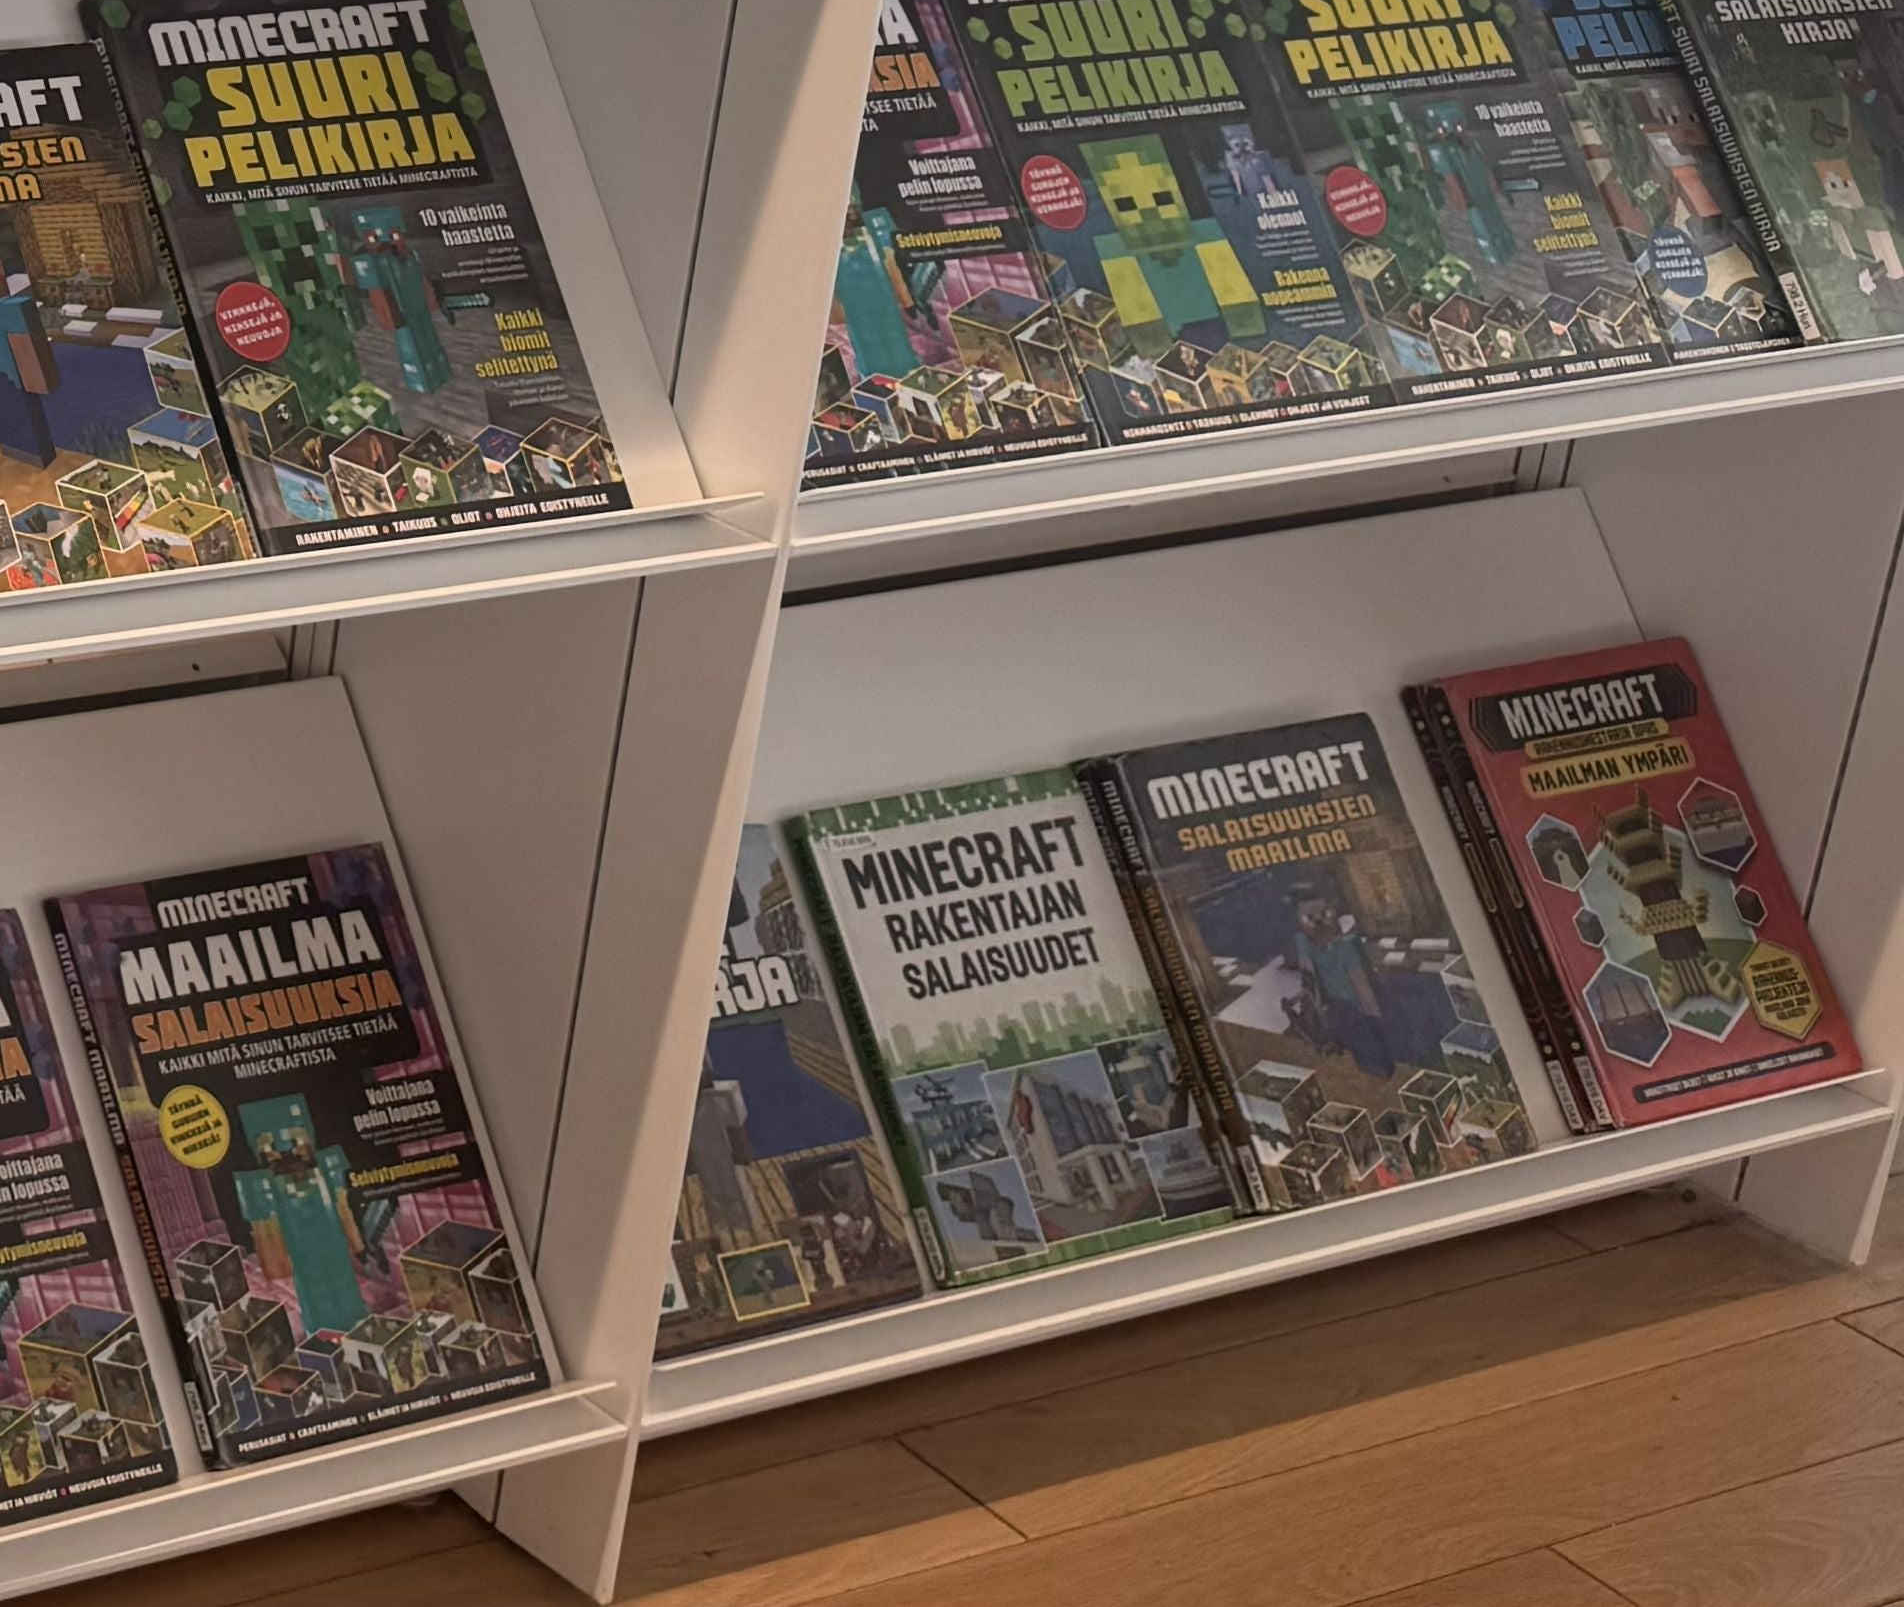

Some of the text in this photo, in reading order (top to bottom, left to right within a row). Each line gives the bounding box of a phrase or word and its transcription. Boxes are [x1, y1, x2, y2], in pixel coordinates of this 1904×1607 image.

[148, 0, 430, 67] MINECRAFT
[1284, 20, 1514, 85] PELIKIRJA
[1780, 18, 1852, 45] KIRJA
[206, 51, 421, 129] SUURI
[996, 50, 1240, 117] PELIKIRJA
[184, 112, 477, 188] PELIKIRJA
[442, 223, 515, 247] haastetta
[1749, 198, 1783, 254] KIRJA
[296, 525, 379, 547] RAKENTAMINEN
[1498, 673, 1665, 741] MINECRAFT
[1147, 740, 1370, 821] MINECRAFT
[1528, 742, 1690, 794] MAAILMAN YMPÄRI
[840, 815, 1086, 911] MINECRAFT
[1225, 829, 1352, 873] MAAILMA
[156, 875, 310, 929] MINECRAFT
[883, 878, 1088, 955] RAKENTAJAN
[119, 908, 384, 1006] MAAILMA
[901, 927, 1101, 1001] SALAISUUDET
[132, 969, 403, 1055] SALAISUUKSIA
[158, 1034, 286, 1075] KAIKKI MITÄ SINUN
